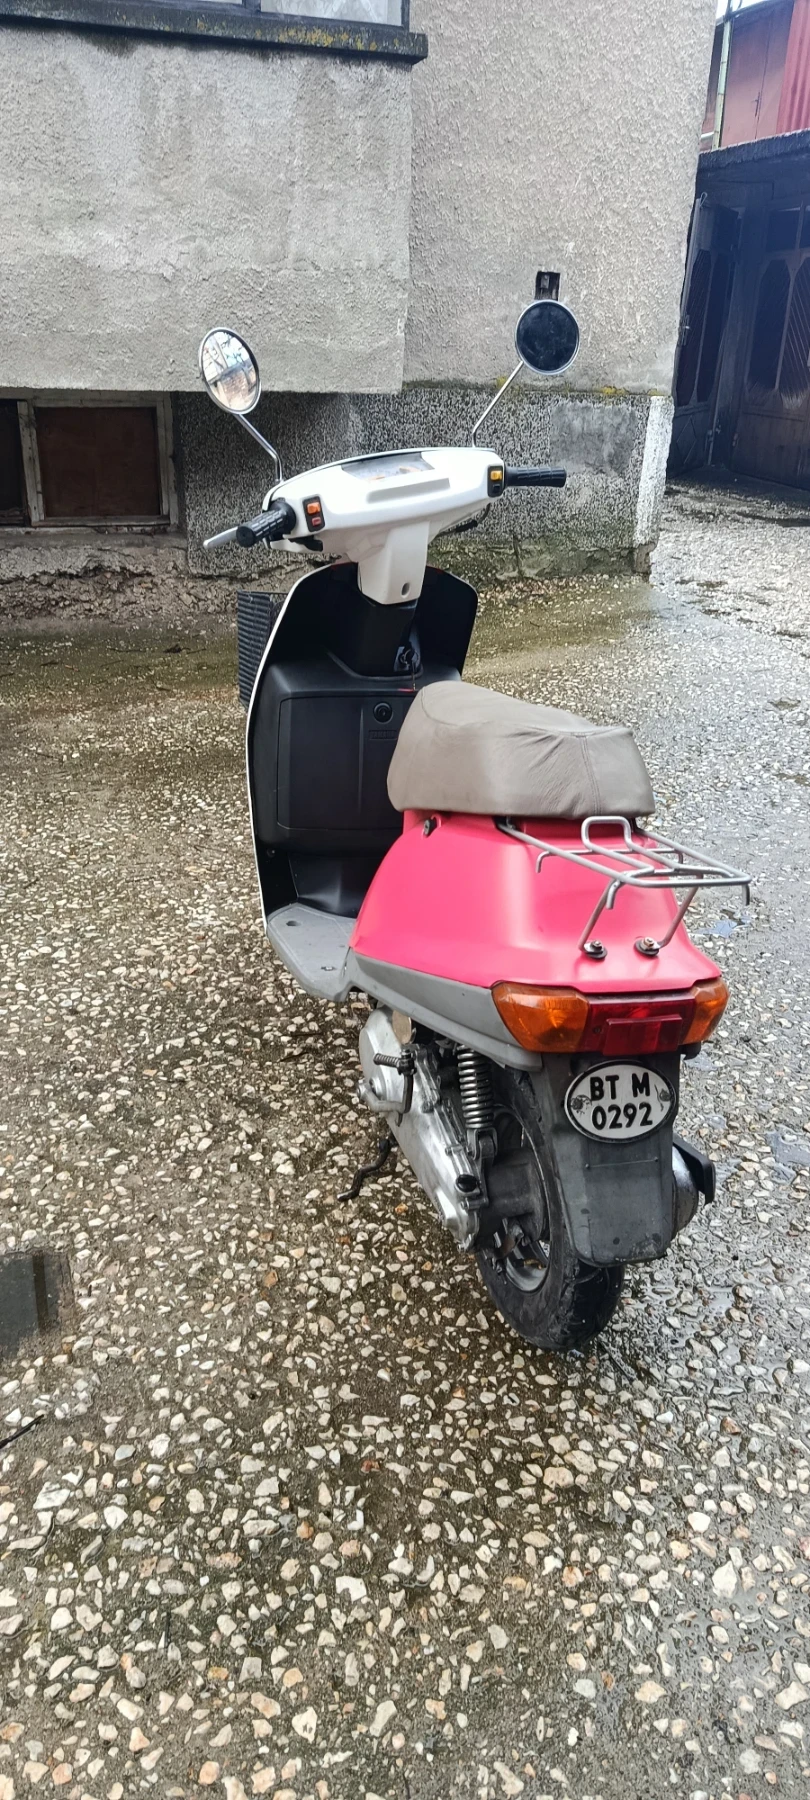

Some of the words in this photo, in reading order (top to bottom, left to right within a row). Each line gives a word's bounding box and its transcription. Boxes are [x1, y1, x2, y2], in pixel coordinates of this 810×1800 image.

[590, 1074, 620, 1101] BT
[631, 1072, 651, 1098] M
[591, 1102, 653, 1131] 0292
